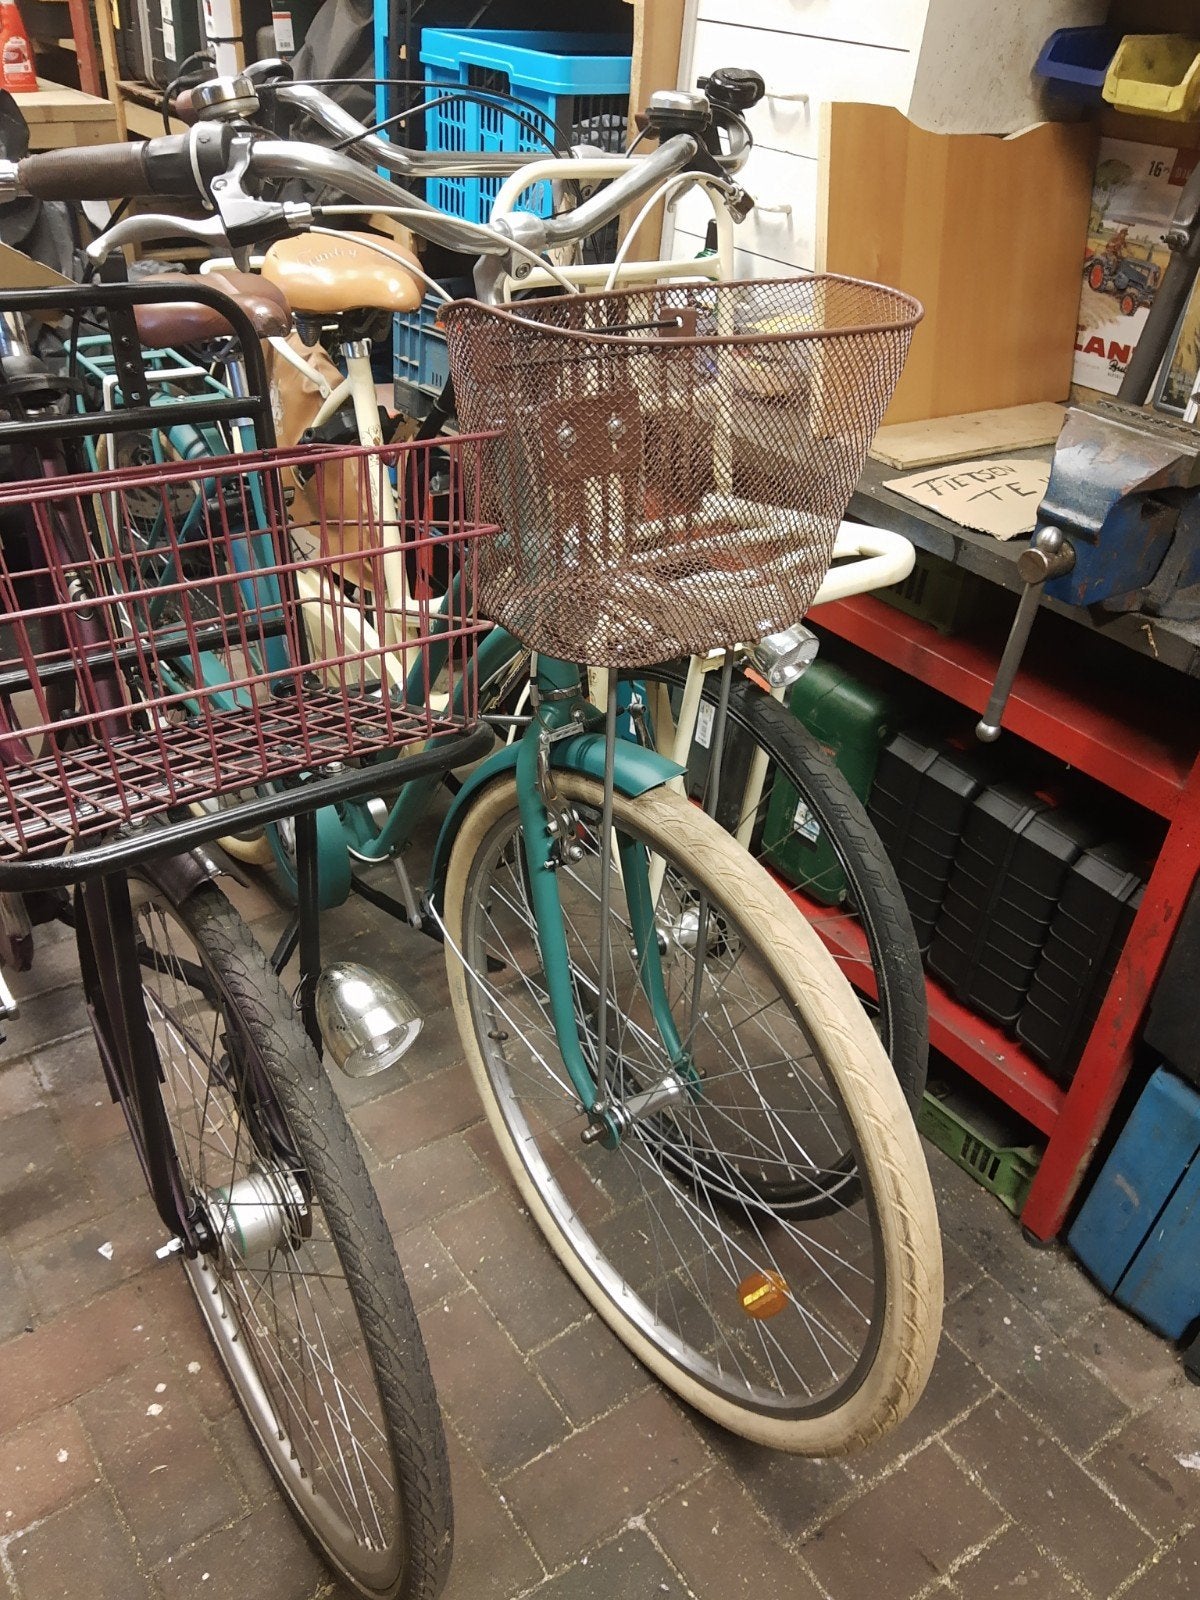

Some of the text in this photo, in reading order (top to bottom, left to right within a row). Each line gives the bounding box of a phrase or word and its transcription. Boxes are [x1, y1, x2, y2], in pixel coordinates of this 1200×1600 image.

[1074, 329, 1137, 364] LAN
[912, 466, 1017, 496] FIETSEN
[966, 481, 1038, 502] TE
